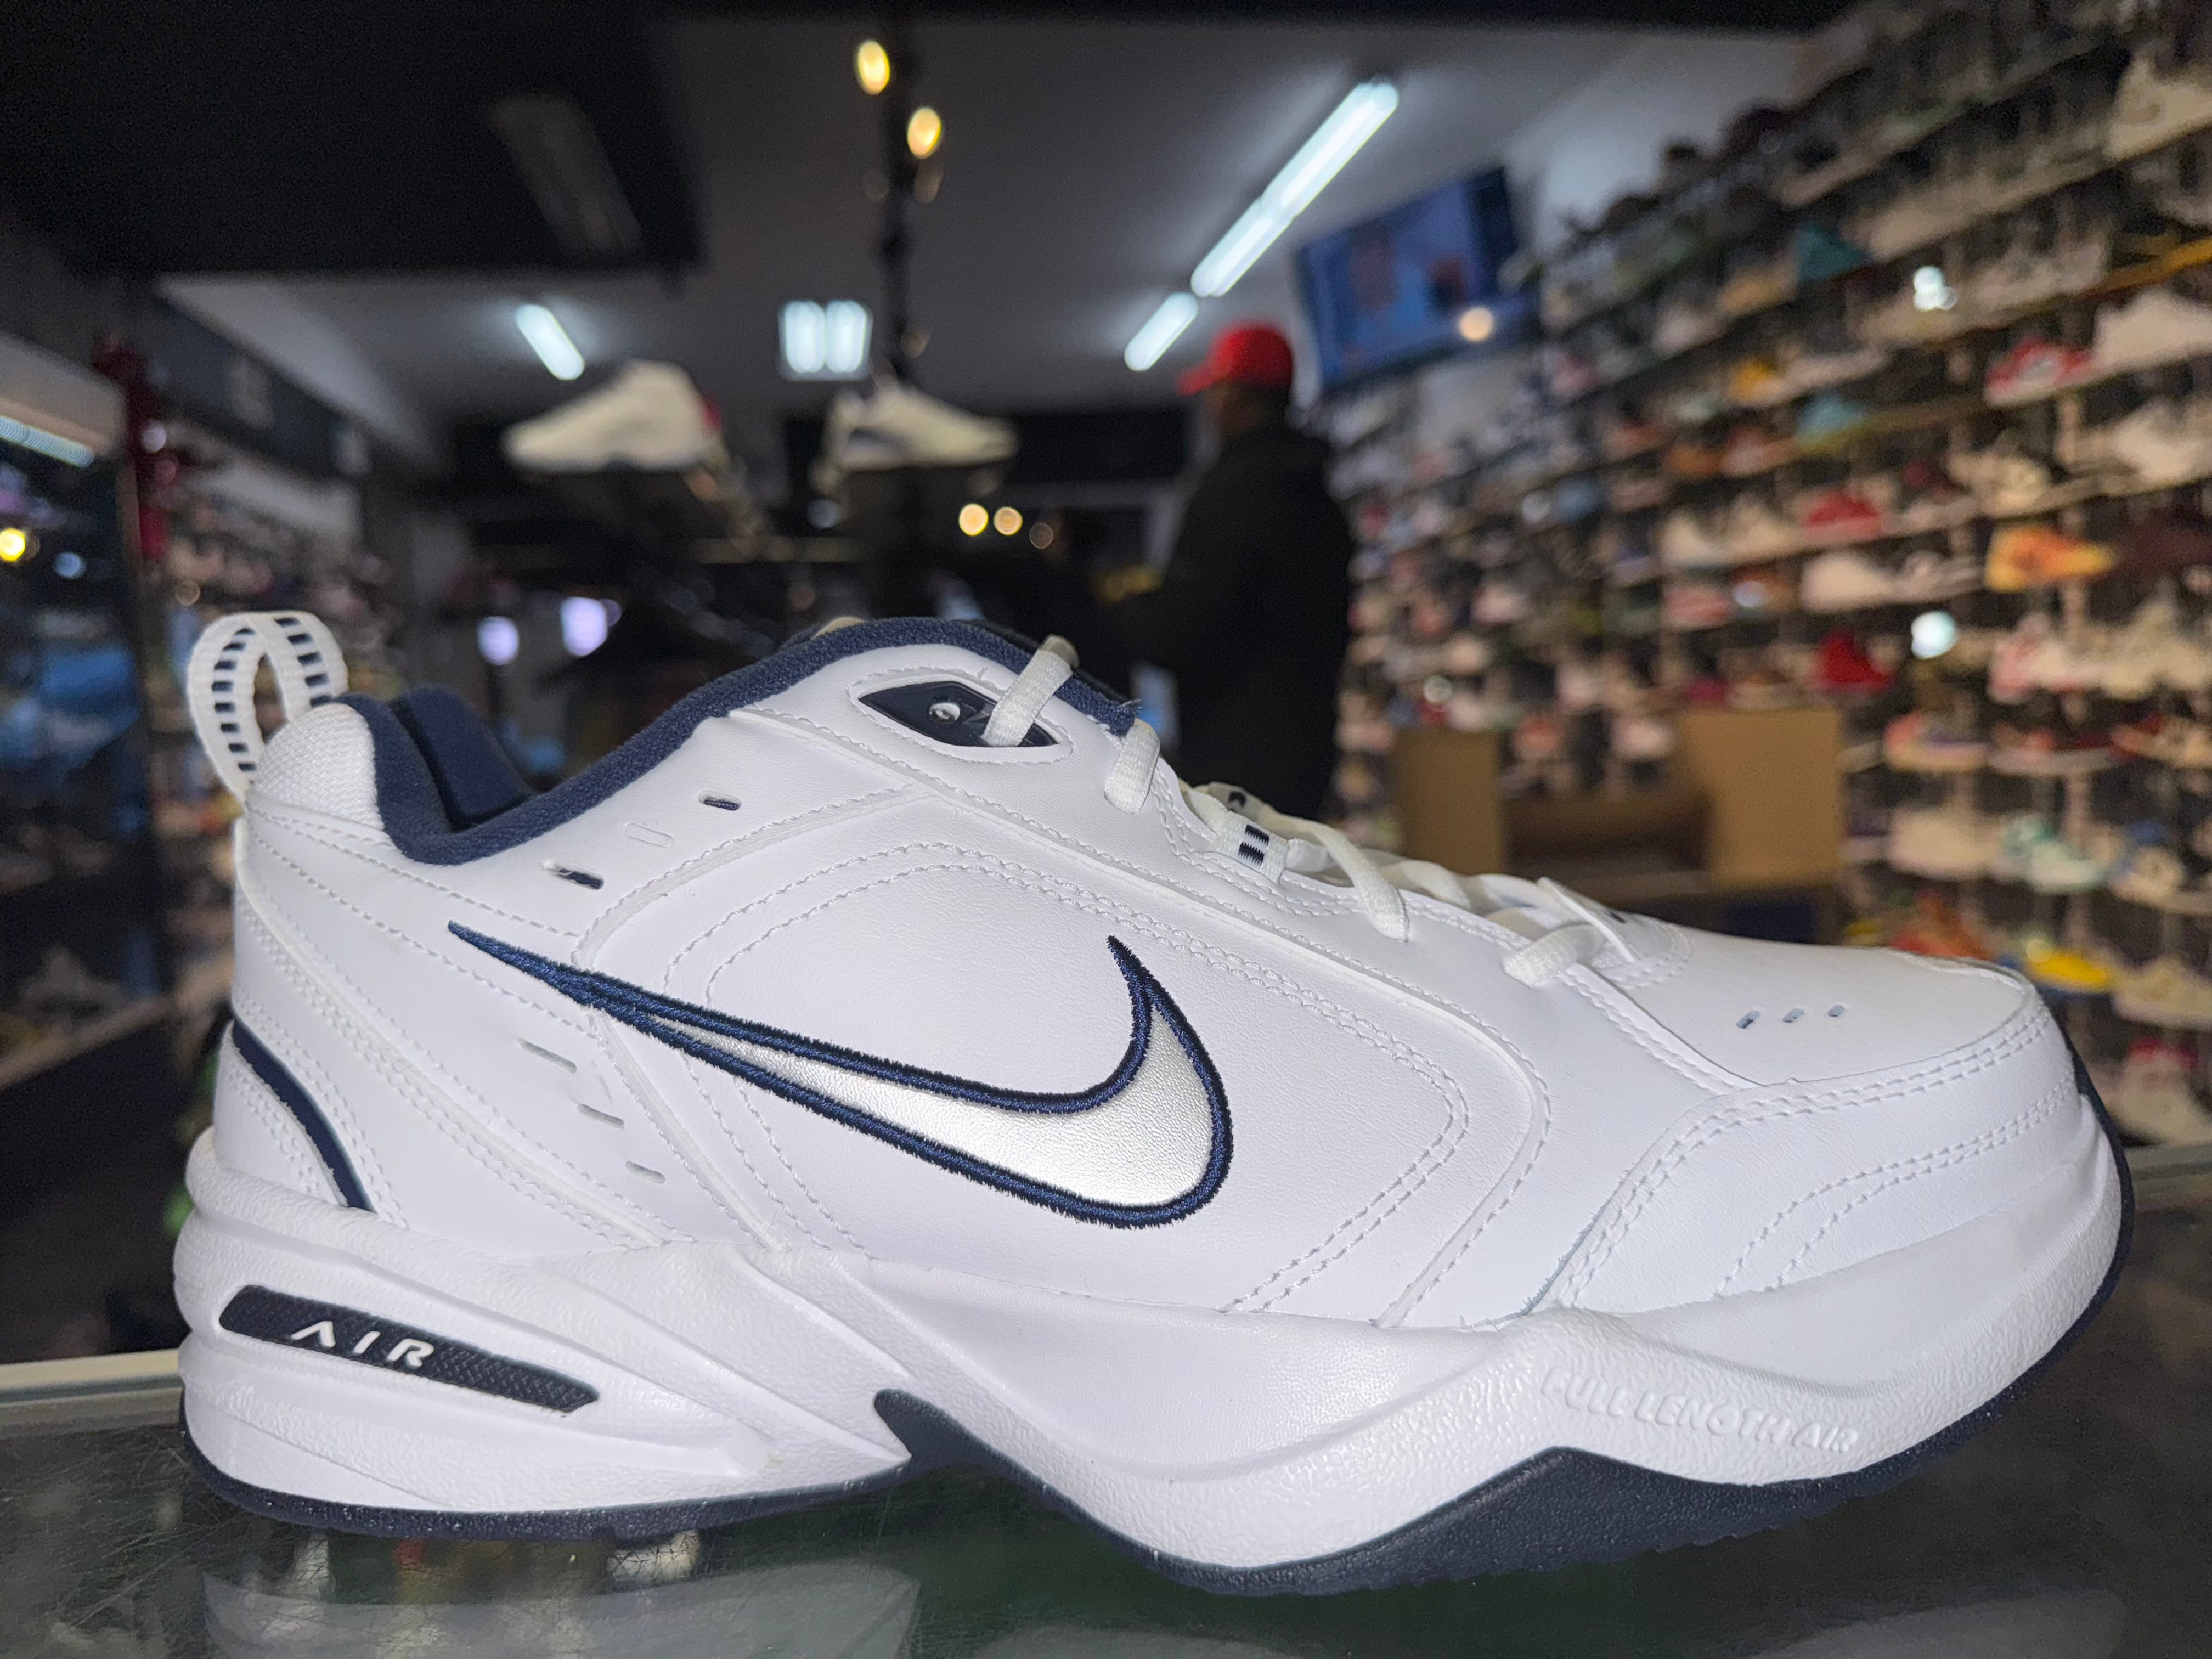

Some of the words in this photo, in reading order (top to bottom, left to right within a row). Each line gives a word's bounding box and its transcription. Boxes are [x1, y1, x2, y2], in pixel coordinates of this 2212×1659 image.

[291, 1320, 435, 1368] AIR
[1541, 1366, 1626, 1418] FULL
[1791, 1421, 1859, 1454] AIR
